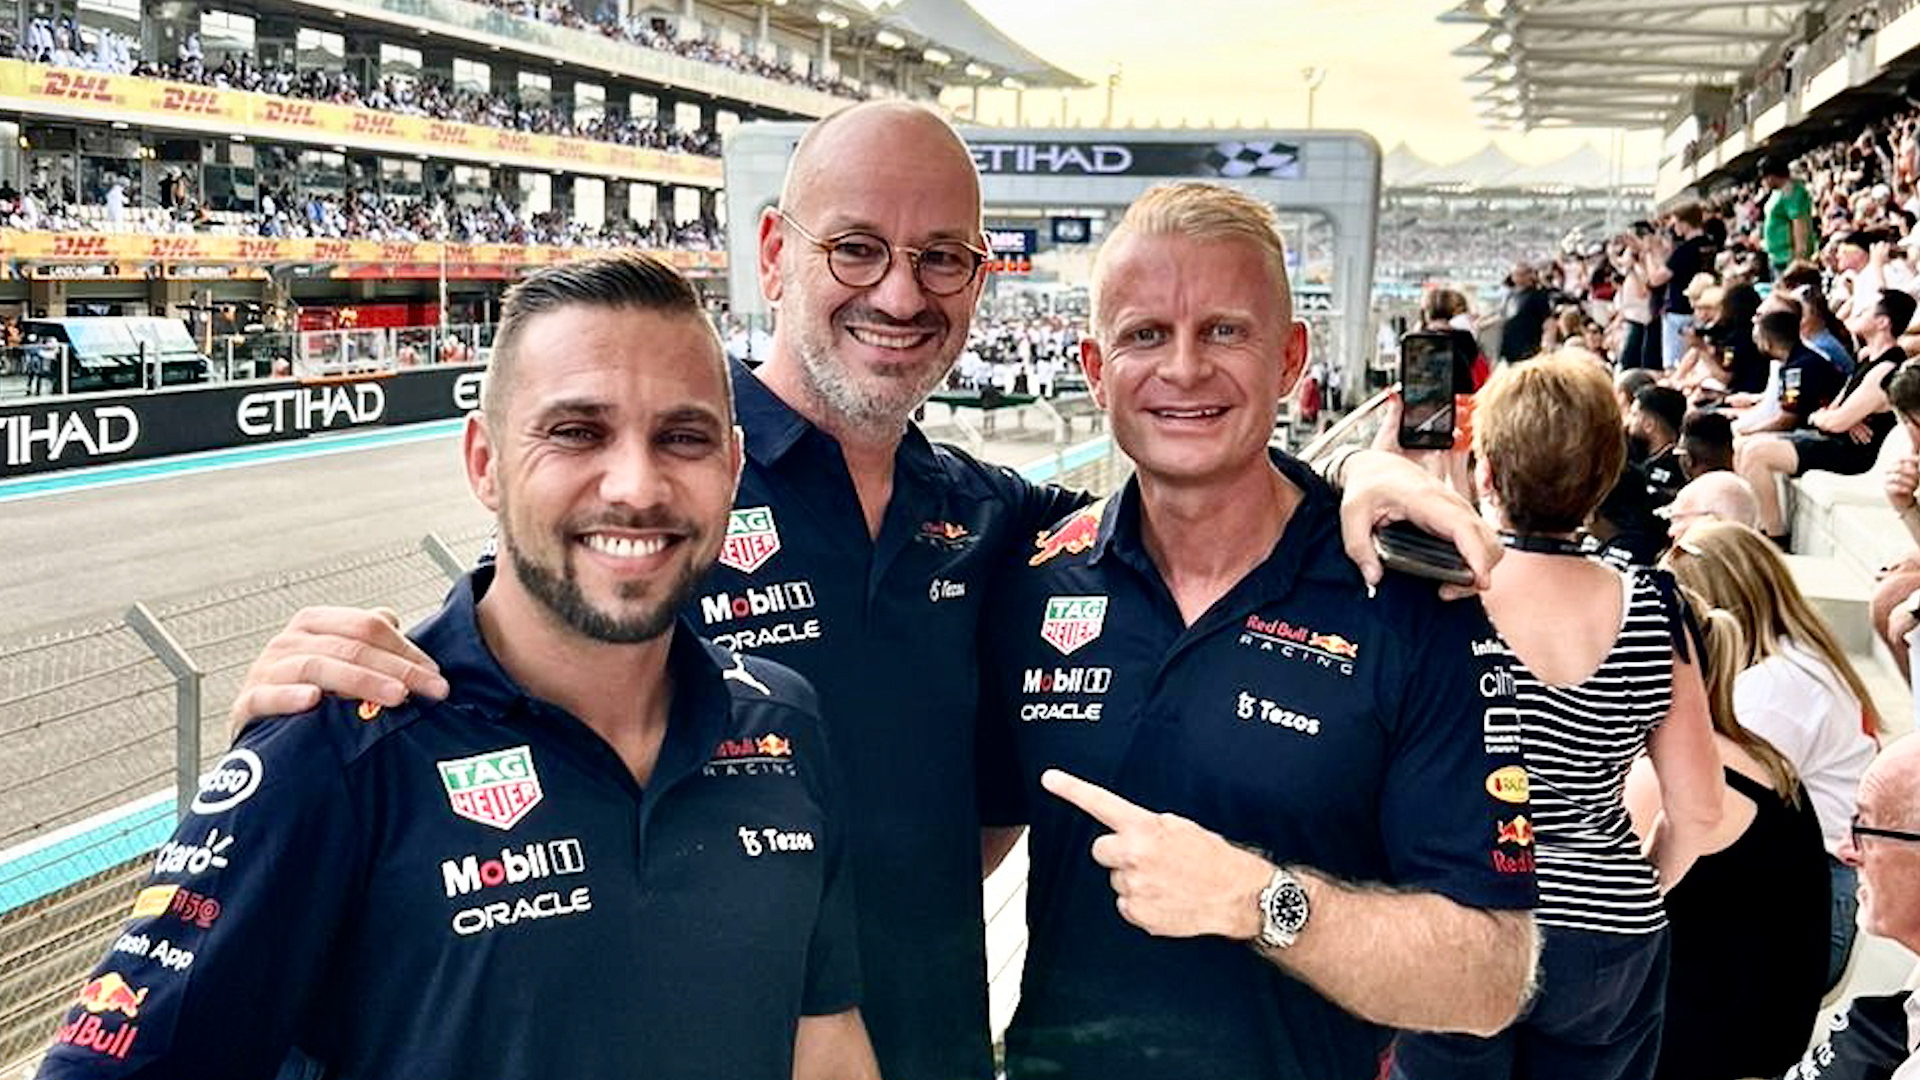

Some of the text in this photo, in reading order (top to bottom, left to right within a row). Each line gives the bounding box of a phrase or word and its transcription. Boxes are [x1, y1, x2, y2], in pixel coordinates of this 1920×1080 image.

[44, 71, 113, 102] DHL
[163, 87, 222, 114] DHL
[264, 100, 318, 126] DHL
[352, 112, 398, 136] DHL
[429, 123, 470, 145] DHL
[53, 235, 110, 256] DHL
[150, 237, 202, 257] DHL
[236, 240, 282, 259] DHL
[314, 242, 352, 260] DHL
[381, 243, 418, 261] DHL
[237, 382, 385, 436] ETIHAD
[0, 406, 139, 465] IHAD
[727, 511, 771, 533] AG
[720, 534, 776, 567] EUER
[700, 585, 787, 624] Mobil
[1051, 601, 1103, 619] TAG
[713, 619, 821, 652] ORACLE
[1045, 621, 1100, 650] HEUER
[1246, 614, 1309, 642] Red Bull
[1239, 633, 1354, 676] RACING
[1023, 667, 1084, 693] Mobil
[1021, 703, 1104, 721] ORACLE
[1260, 700, 1321, 736] Tezos
[447, 755, 527, 788] TAG
[454, 781, 537, 823] HEUER
[762, 828, 815, 851] Tezos
[442, 843, 550, 898] Mobil
[453, 887, 593, 935] ORACLE
[149, 939, 194, 972] App
[75, 1014, 138, 1058] Bull
